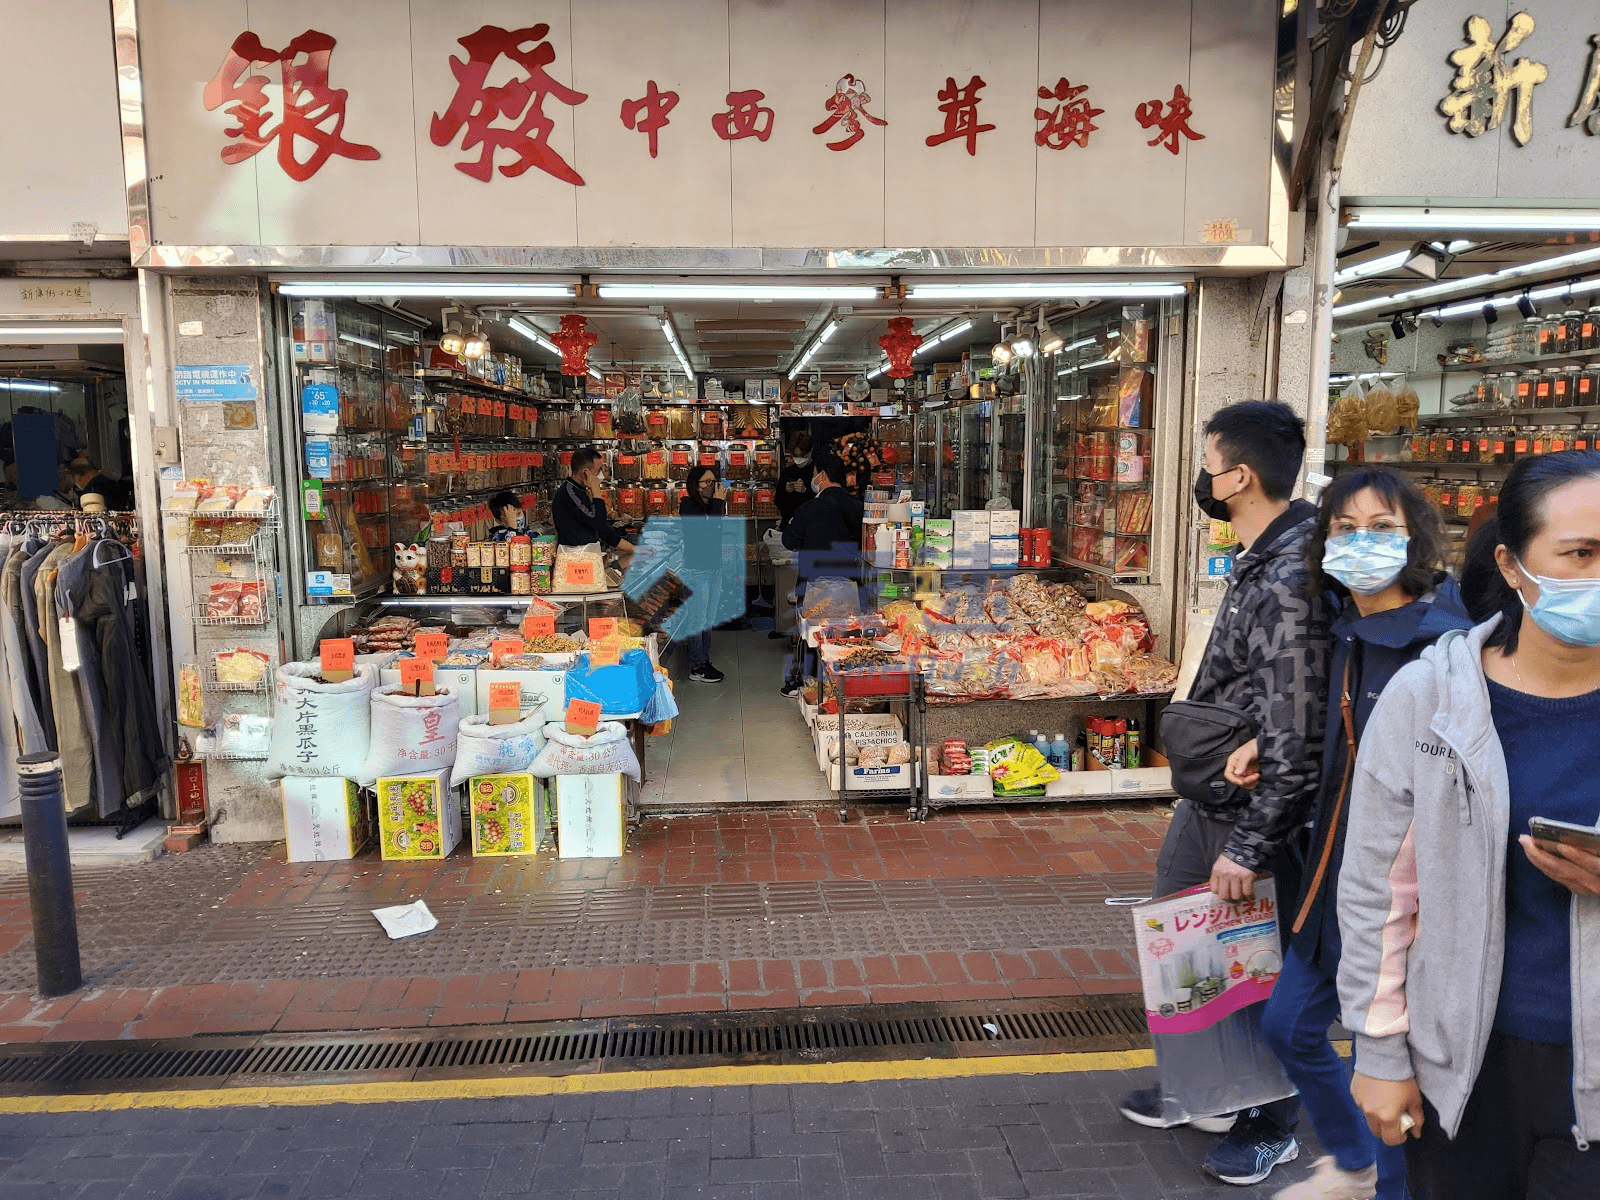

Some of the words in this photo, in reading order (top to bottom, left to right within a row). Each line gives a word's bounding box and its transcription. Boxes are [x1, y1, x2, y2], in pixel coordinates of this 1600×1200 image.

[203, 23, 588, 186] 銀發
[854, 729, 898, 738] CALIFORNIA
[855, 737, 898, 746] PISTACHIOS
[1175, 898, 1274, 932] レンジパネル
